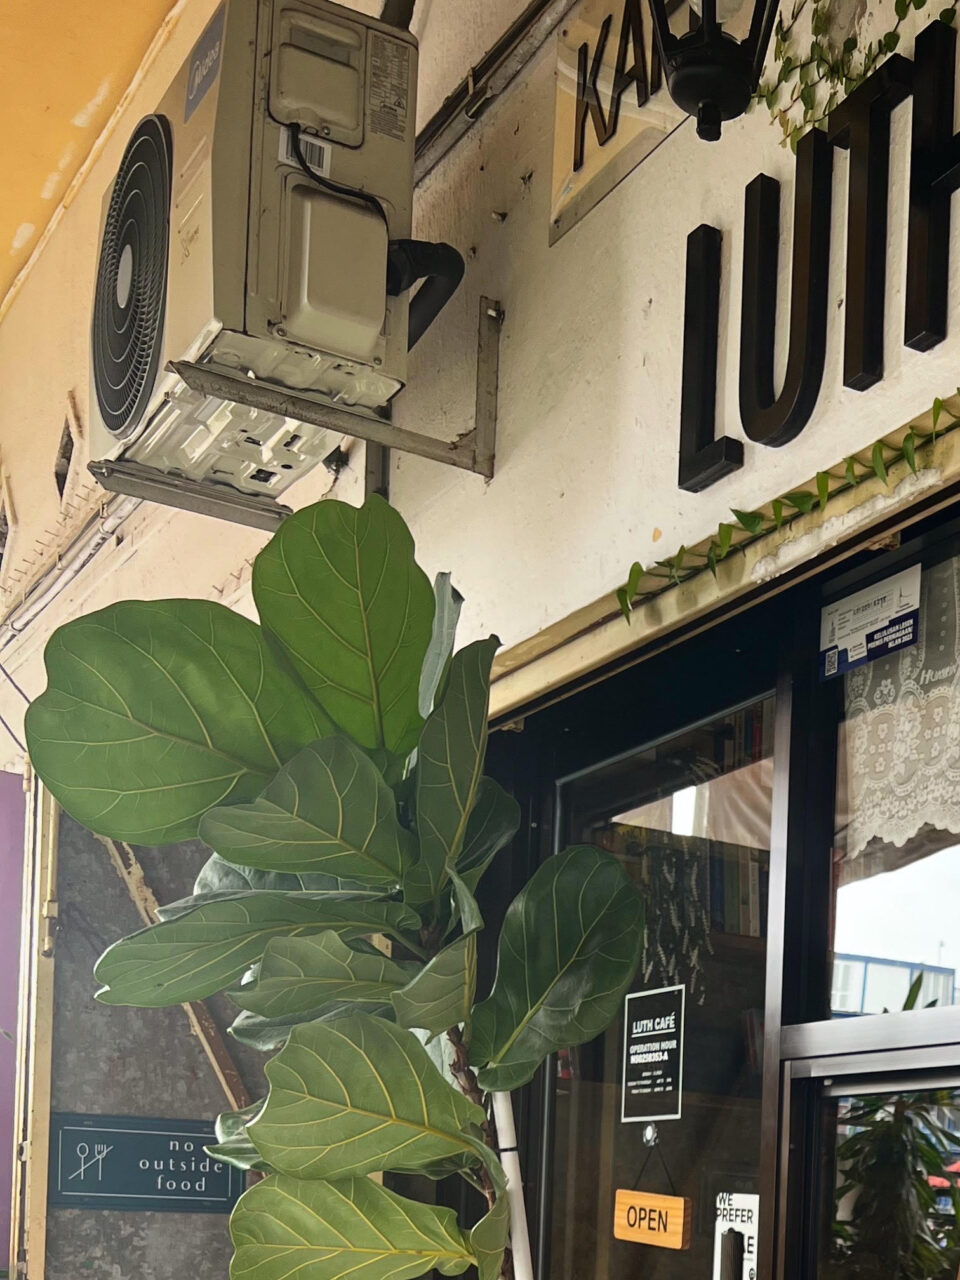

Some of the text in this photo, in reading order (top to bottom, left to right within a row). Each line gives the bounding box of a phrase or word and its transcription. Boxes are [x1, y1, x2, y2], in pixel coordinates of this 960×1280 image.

[632, 1011, 676, 1034] LUTH CAFÉ
[169, 1140, 195, 1153] no
[138, 1156, 224, 1174] outside
[156, 1174, 206, 1192] food
[626, 1205, 669, 1233] OPEN
[716, 1207, 754, 1224] PREFER
